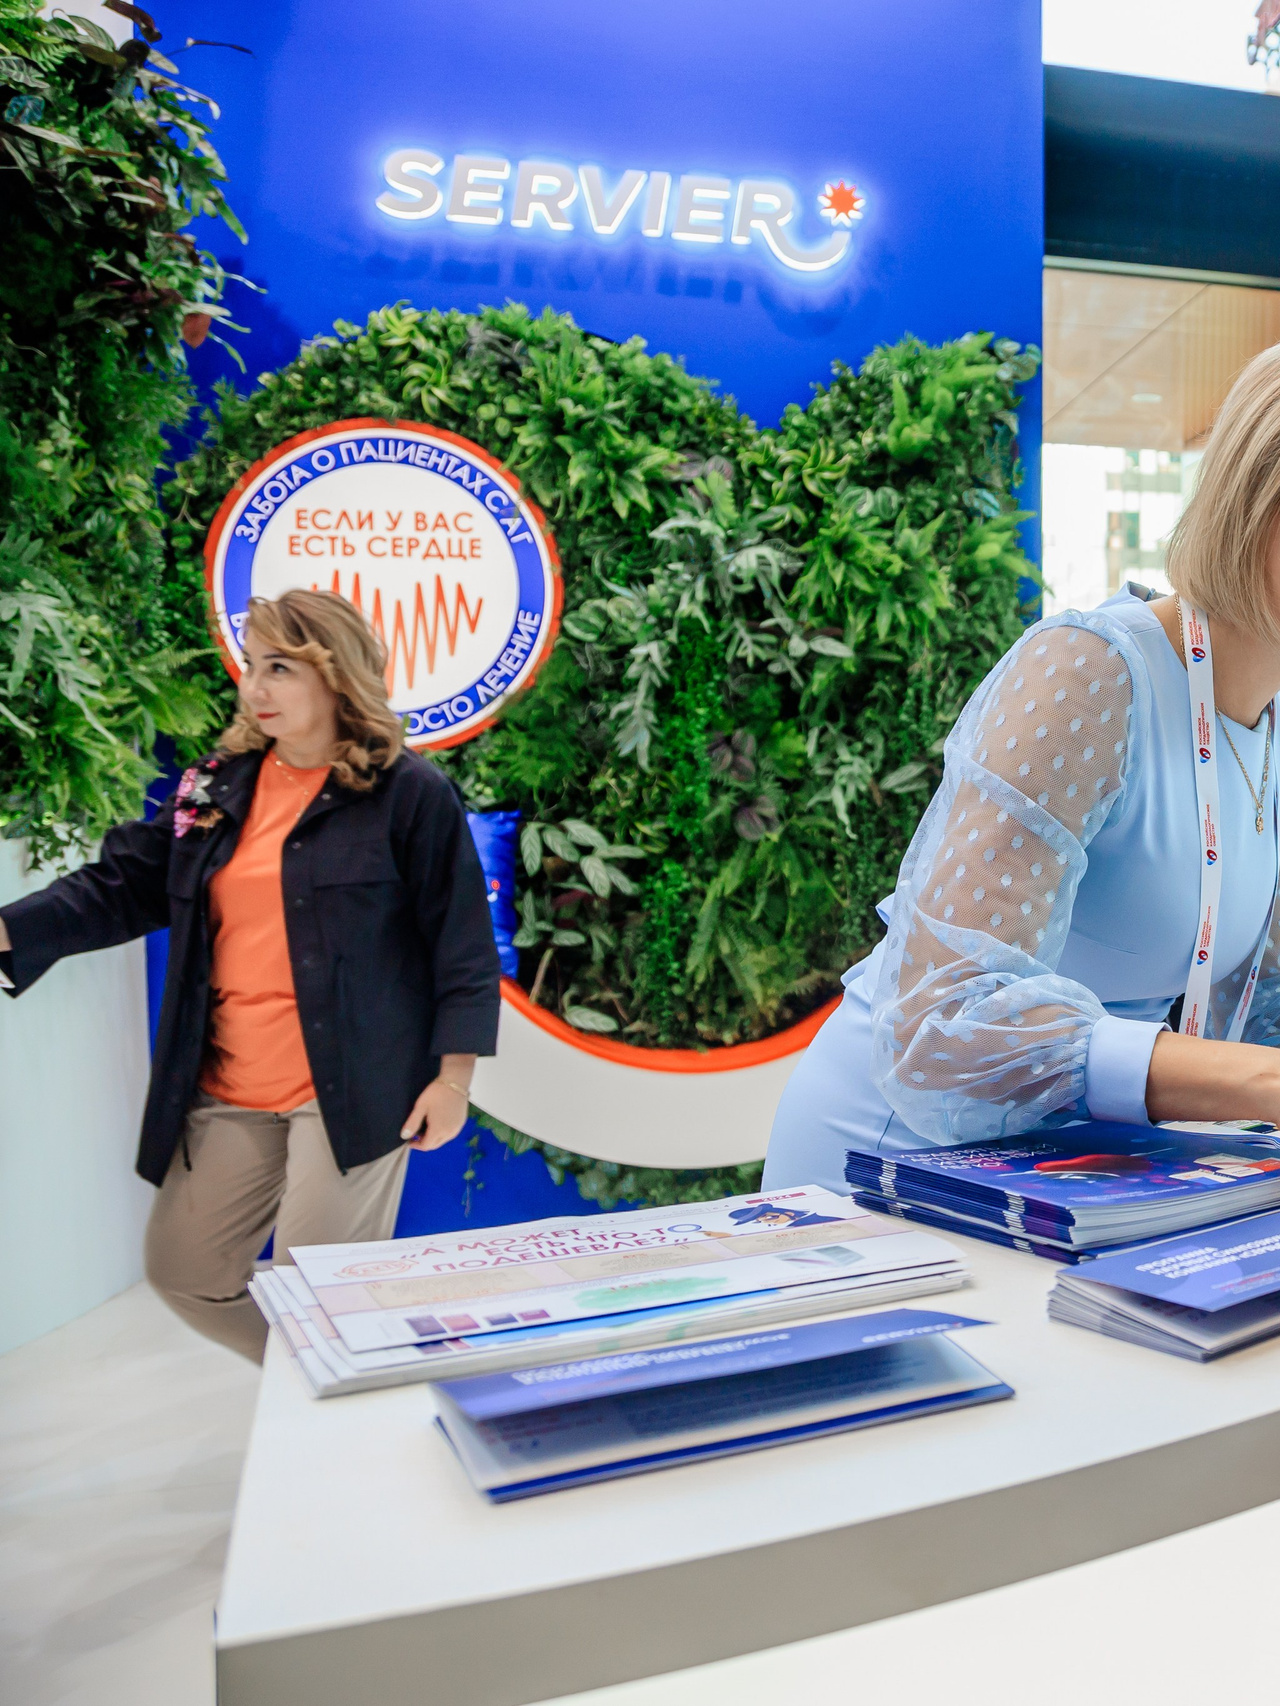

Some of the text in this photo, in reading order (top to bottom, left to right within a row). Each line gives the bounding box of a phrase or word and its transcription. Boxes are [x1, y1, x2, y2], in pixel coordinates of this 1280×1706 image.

[376, 149, 851, 272] SERVIER
[235, 463, 312, 543] ЗАБОТА
[311, 449, 336, 472] О
[339, 438, 490, 496] ПАЦИЕНТАХ
[484, 489, 509, 514] С
[295, 508, 473, 533] ЕСЛИ У ВАС
[288, 534, 482, 560] ЕСТЬ СЕРДЦЕ
[405, 609, 541, 735] ОСТО ЛЕЧЕНИЕ
[484, 1239, 565, 1257] ЕСТЬ
